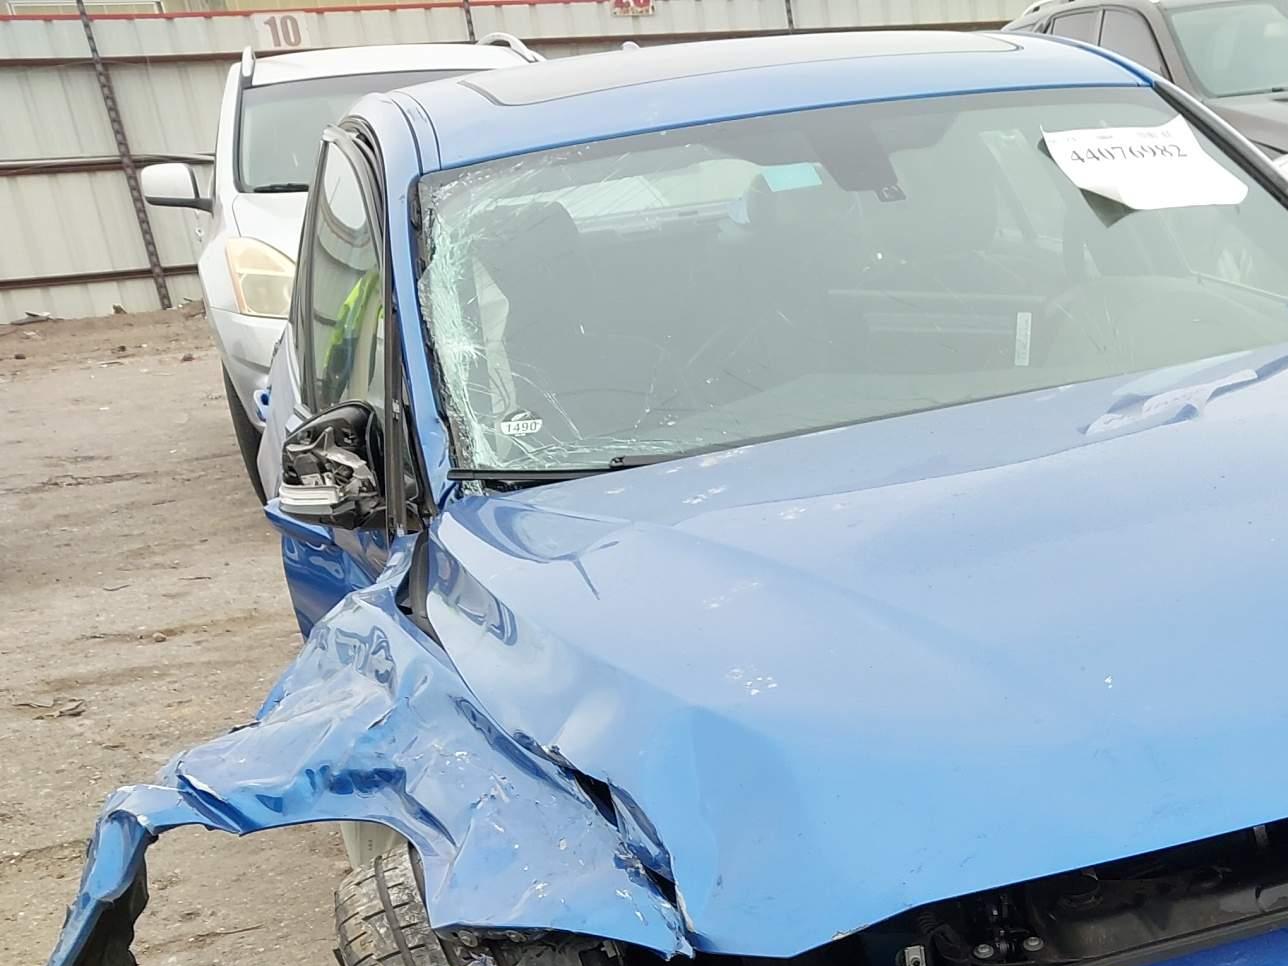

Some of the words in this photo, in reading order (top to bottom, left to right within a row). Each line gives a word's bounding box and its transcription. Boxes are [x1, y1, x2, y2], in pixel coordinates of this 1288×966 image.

[263, 15, 302, 47] 10
[1071, 143, 1188, 164] 44076982
[506, 421, 537, 433] 1490
